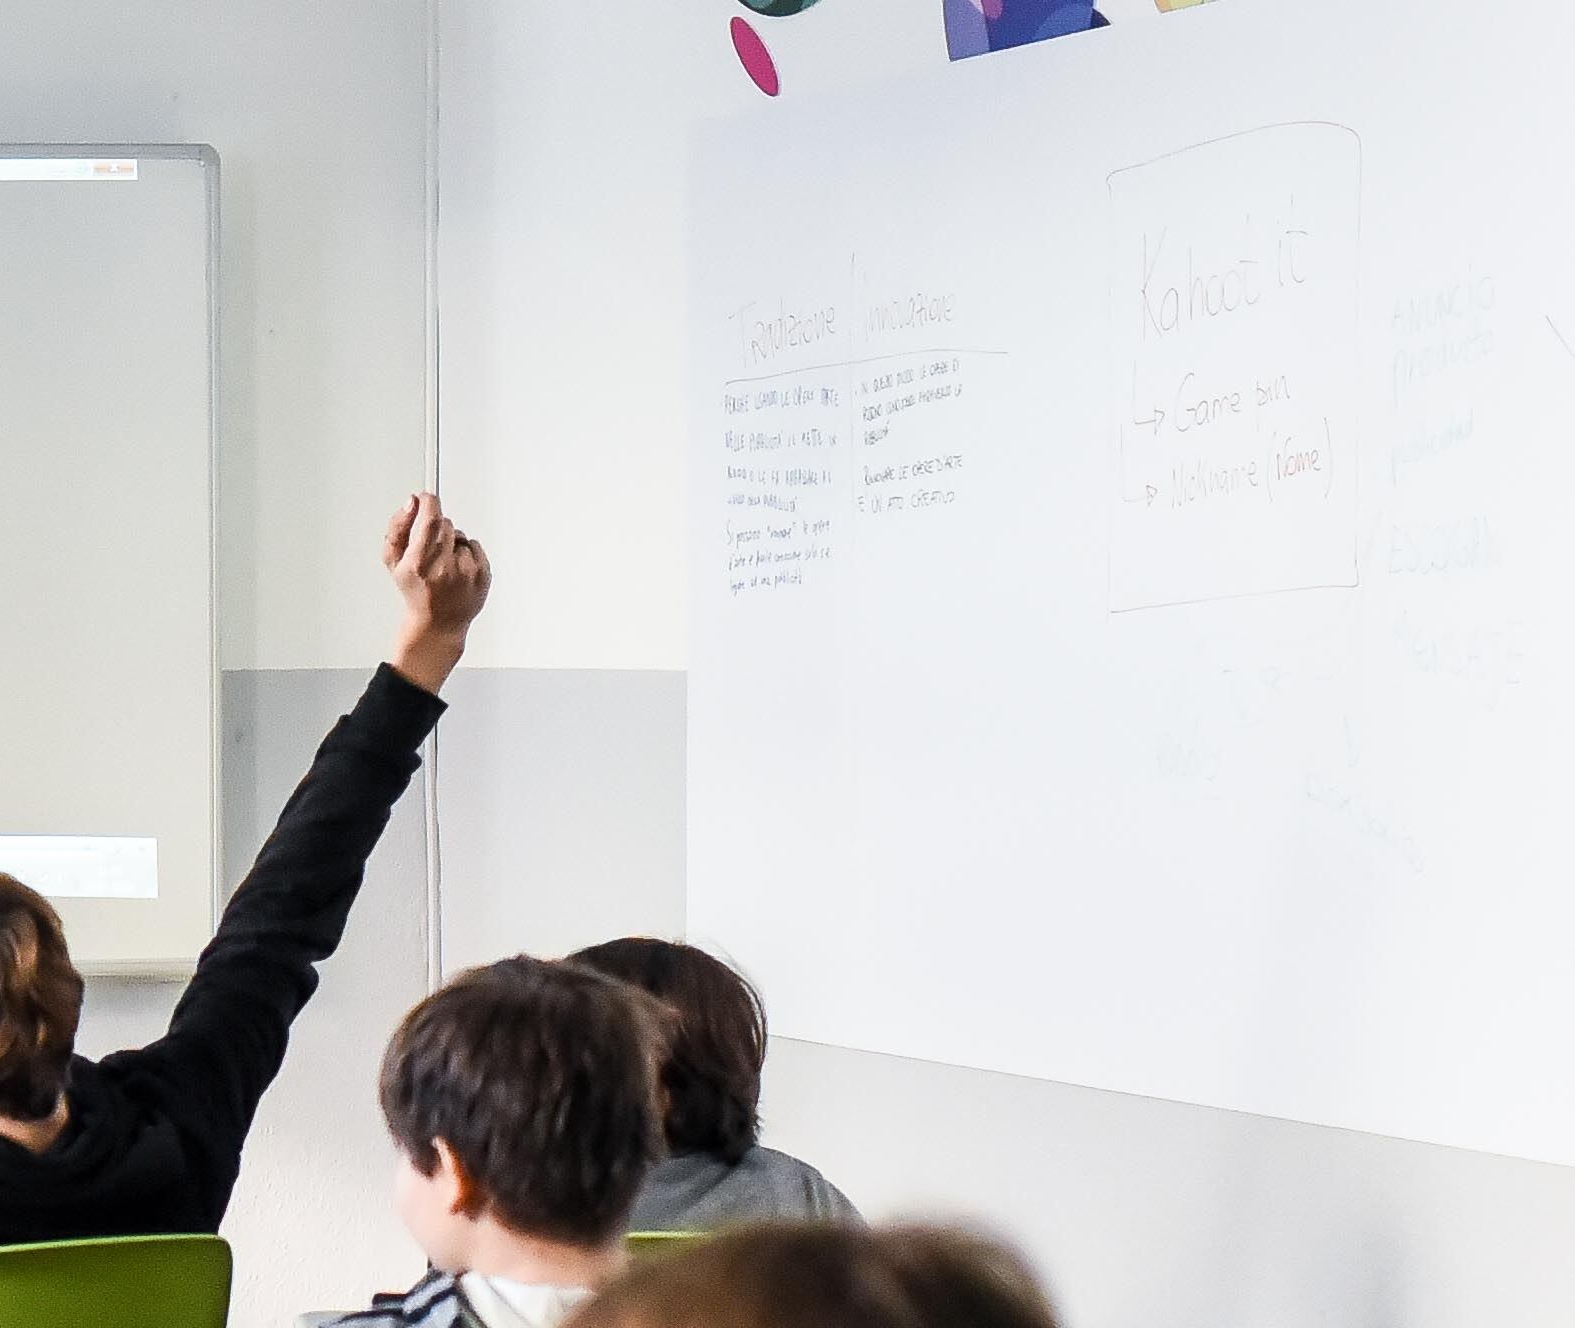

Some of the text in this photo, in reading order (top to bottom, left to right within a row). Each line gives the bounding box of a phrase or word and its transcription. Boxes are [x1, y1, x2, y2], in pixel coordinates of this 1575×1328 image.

[1140, 213, 1261, 341] Kahoot
[1173, 372, 1291, 431] Game pin
